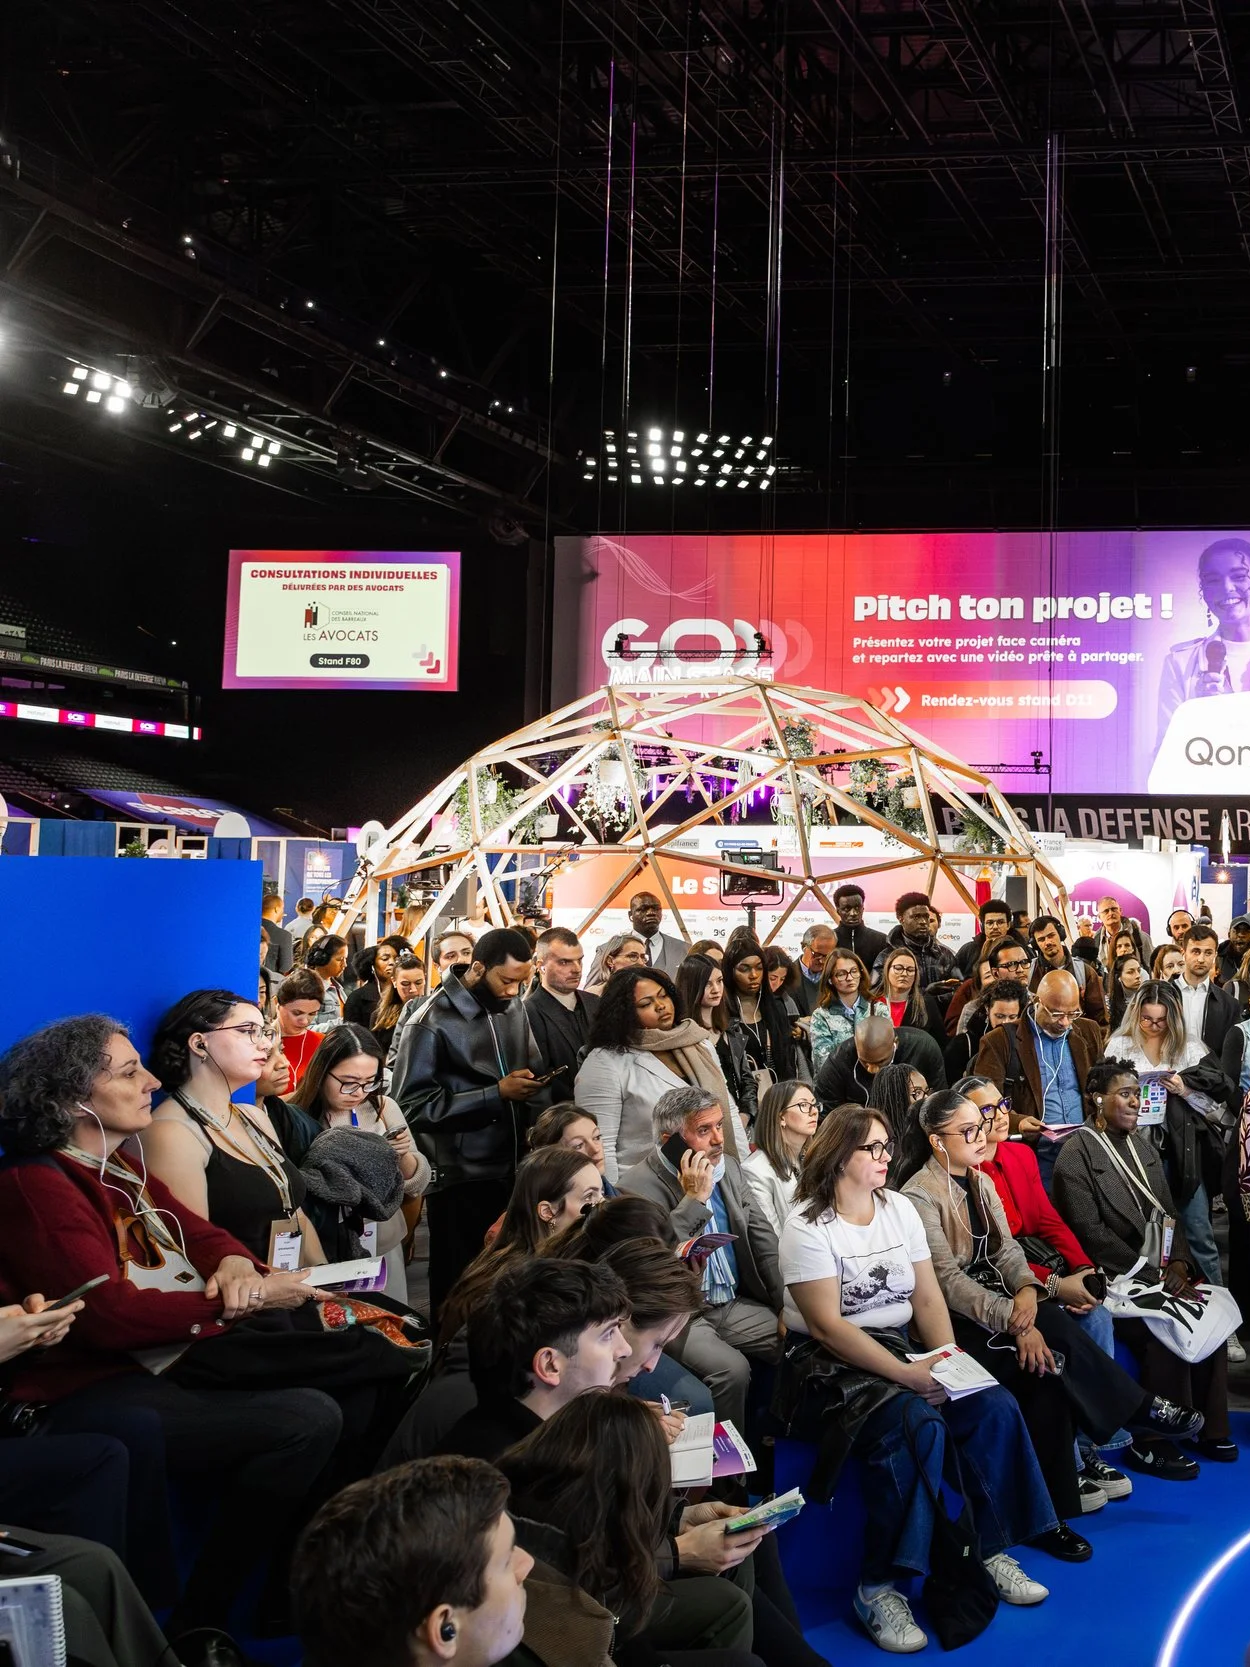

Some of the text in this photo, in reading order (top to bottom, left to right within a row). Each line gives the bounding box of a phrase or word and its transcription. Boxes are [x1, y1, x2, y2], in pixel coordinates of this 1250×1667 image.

[250, 569, 438, 580] CONSULTATIONS INDIVIDUELLES
[282, 582, 327, 591] DÉLIVRÉES
[347, 584, 364, 592] DES
[365, 584, 405, 592] AVOCATS
[853, 591, 1174, 624] Pitch ton projet !
[303, 630, 379, 642] LES AVOCATS
[853, 634, 1081, 650] Présentez votre projet face caméra
[318, 657, 362, 666] Stand F80
[852, 650, 1144, 665] et repartez avec une vidéo prête à partager.
[921, 694, 1013, 707] Rendez-vous
[1018, 694, 1061, 707] stand
[1078, 808, 1211, 841] DEFENSE
[672, 876, 698, 894] Le
